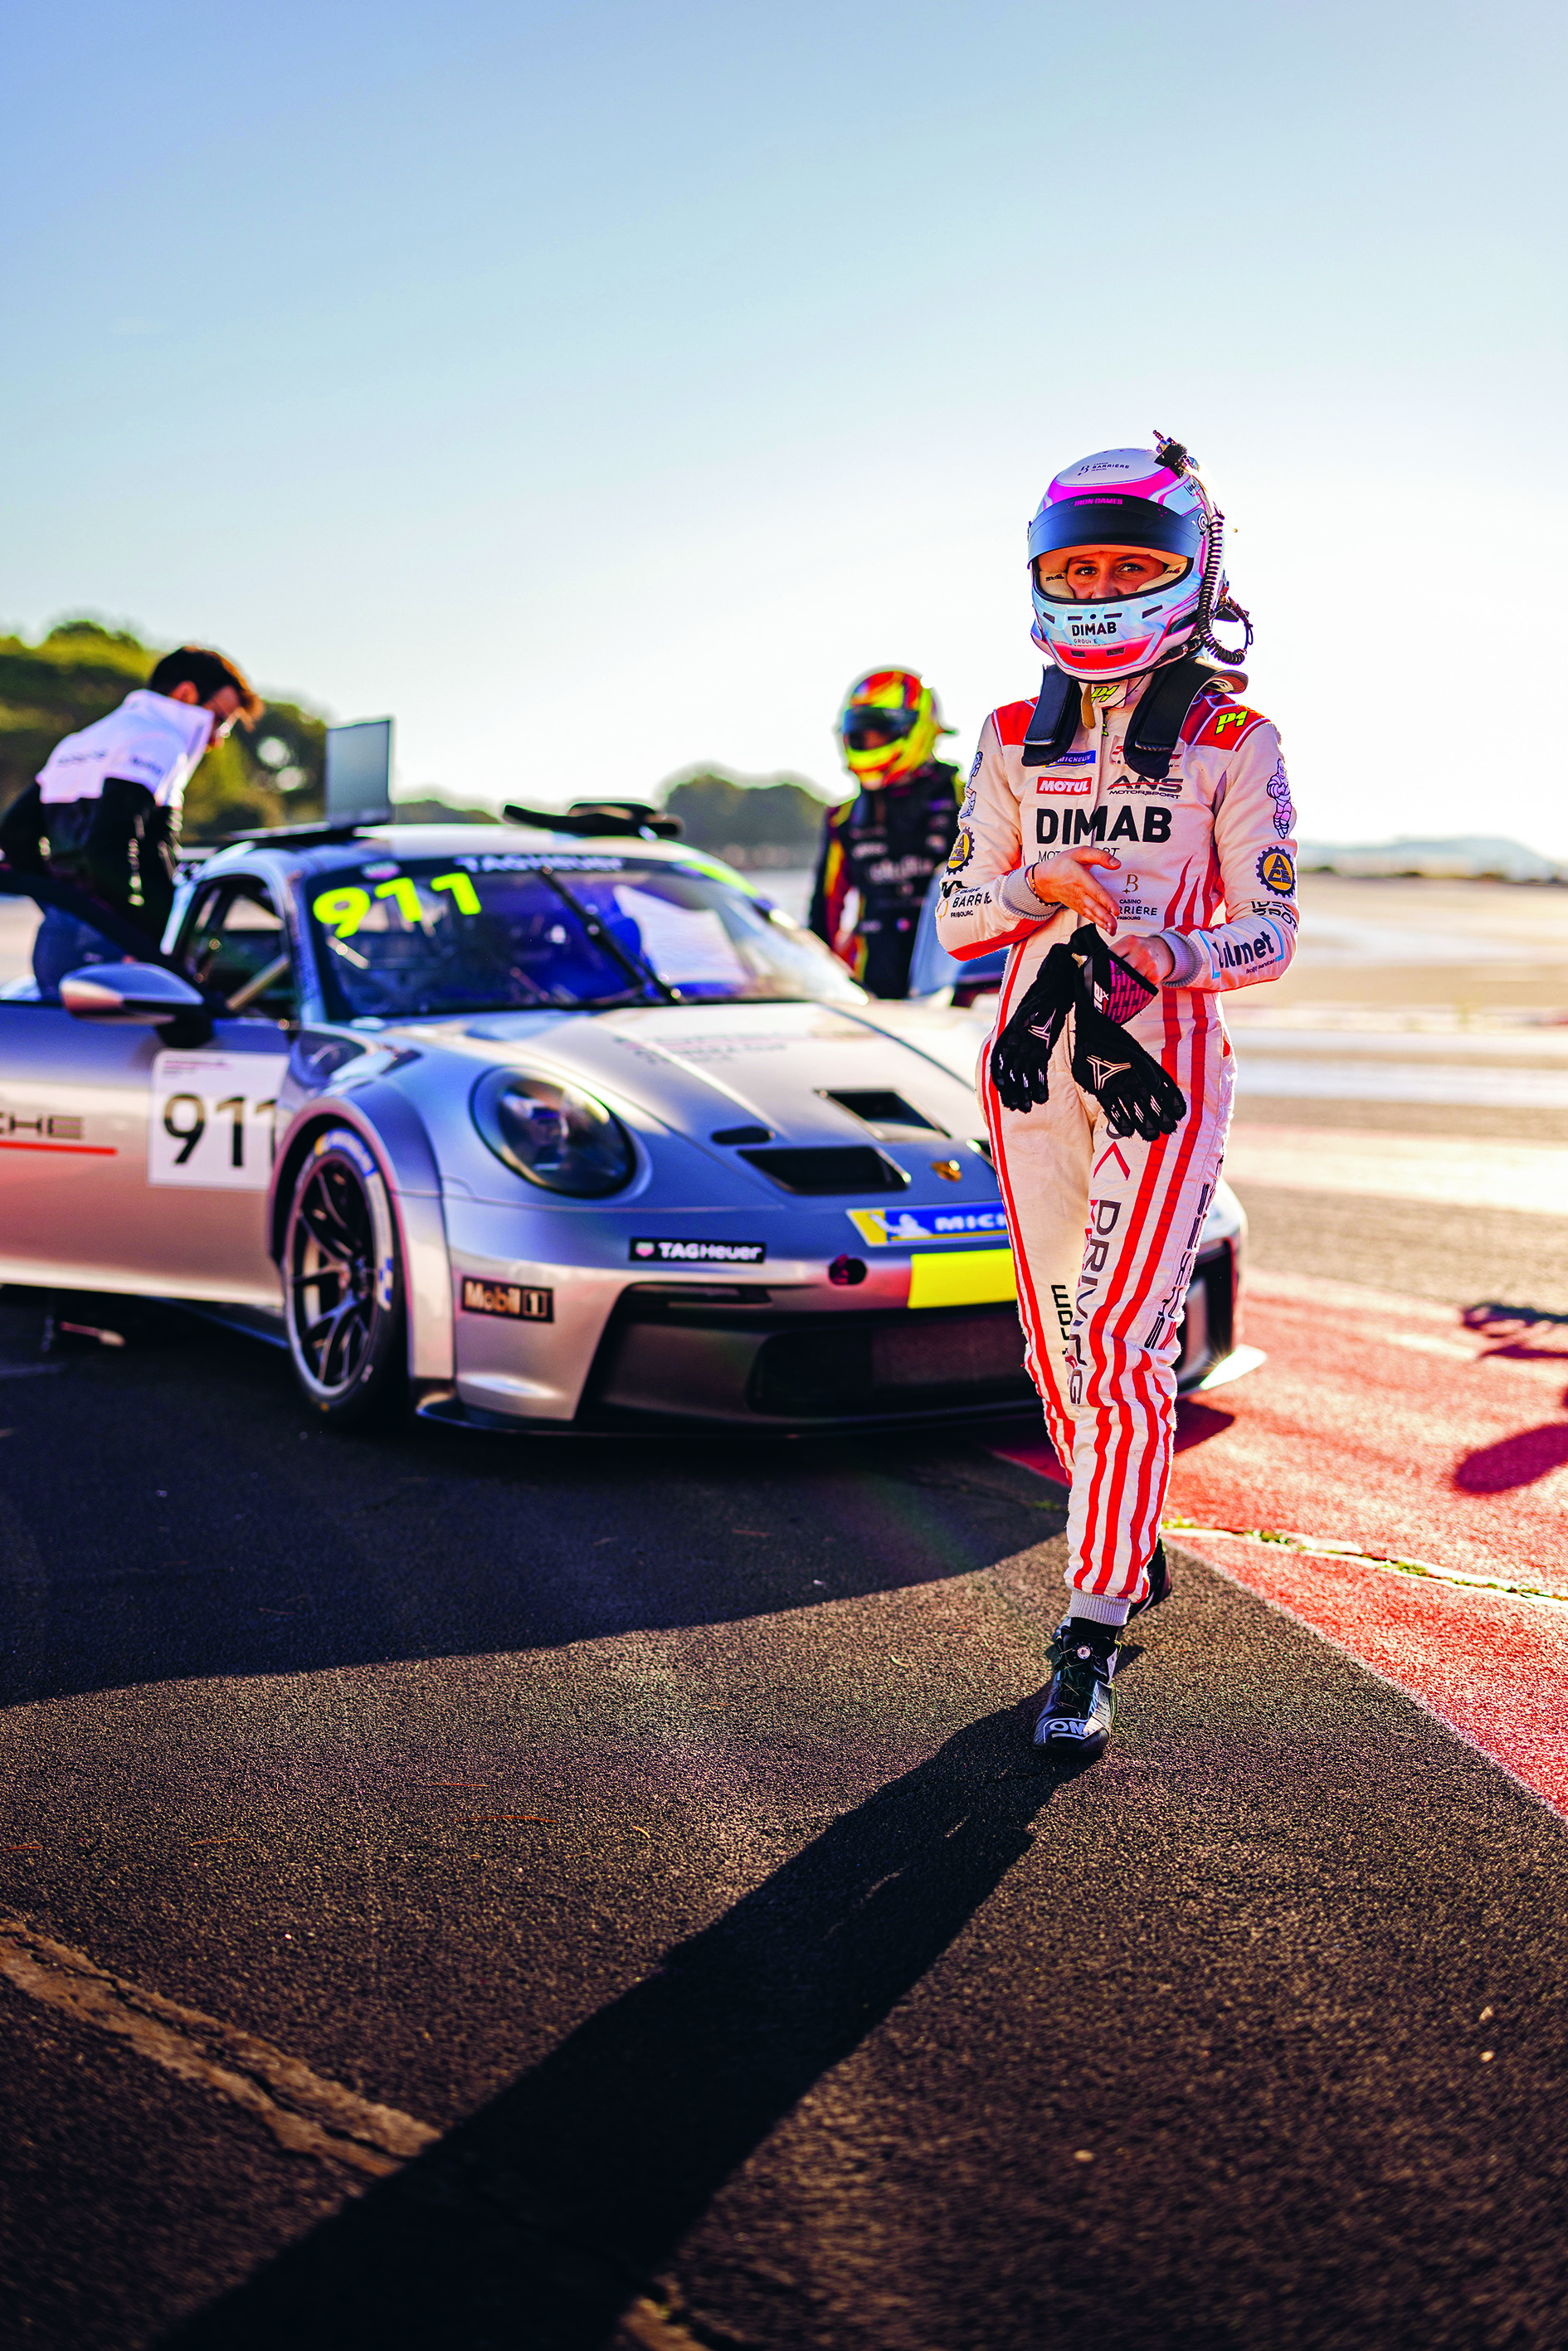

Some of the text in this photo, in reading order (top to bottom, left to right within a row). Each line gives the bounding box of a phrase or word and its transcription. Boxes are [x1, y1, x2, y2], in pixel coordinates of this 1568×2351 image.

[1074, 499, 1094, 507] IRON
[1072, 621, 1117, 636] DIMAB
[1215, 711, 1248, 735] P1
[1057, 754, 1092, 762] MICHELIN
[1039, 780, 1089, 793] MOTUL
[1107, 775, 1184, 794] ANS
[1108, 790, 1181, 799] MOTORSPORT
[1036, 806, 1172, 845] DIMAB
[313, 872, 482, 938] 911
[1118, 905, 1157, 916] RRIÈRE
[465, 1281, 521, 1314] Mobil
